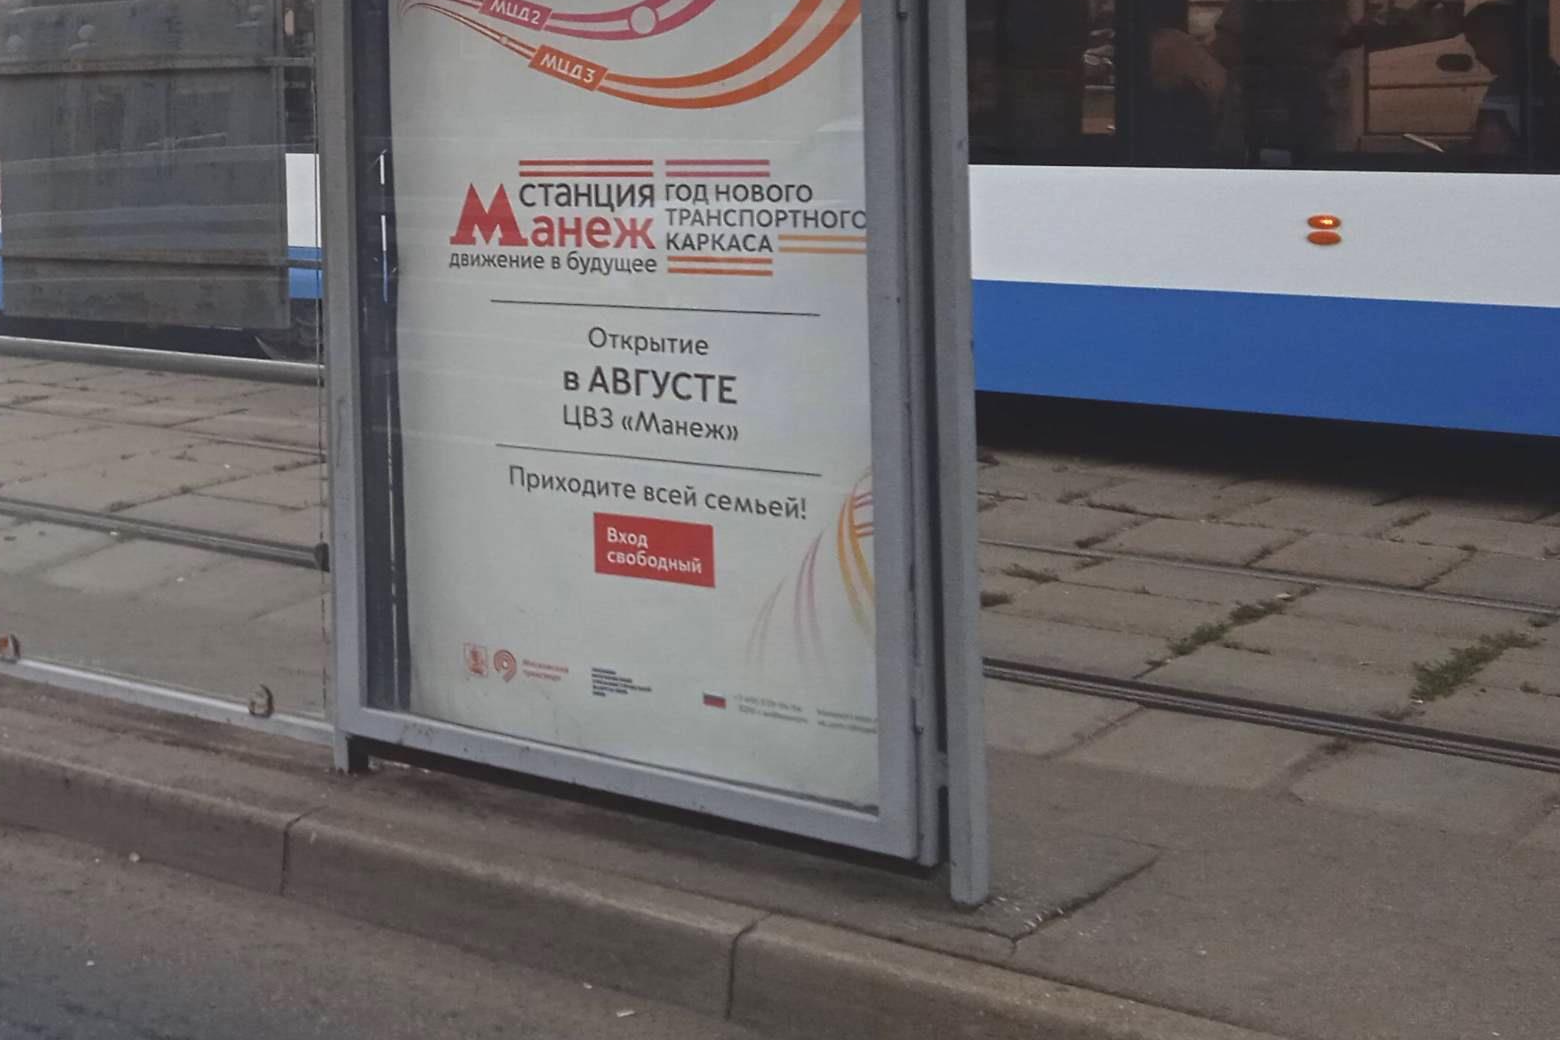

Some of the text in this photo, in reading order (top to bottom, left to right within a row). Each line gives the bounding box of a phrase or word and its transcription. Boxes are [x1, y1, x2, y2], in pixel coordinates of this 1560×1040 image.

[540, 53, 596, 84] МЦД3
[665, 183, 813, 205] ГОД НОВОГО
[450, 183, 657, 249] Манеж
[666, 208, 867, 230] ТРАНСПОРТНОГО
[666, 233, 773, 253] КАРКАСА
[450, 251, 657, 274] движение в будущее
[588, 327, 709, 355] Открытие
[563, 366, 738, 404] в АВГУСТЕ
[563, 405, 739, 441] ЦВЗ «Манеж»
[509, 465, 807, 520] Приходите всей семьей!
[607, 528, 648, 549] Вход
[607, 550, 702, 574] свободный
